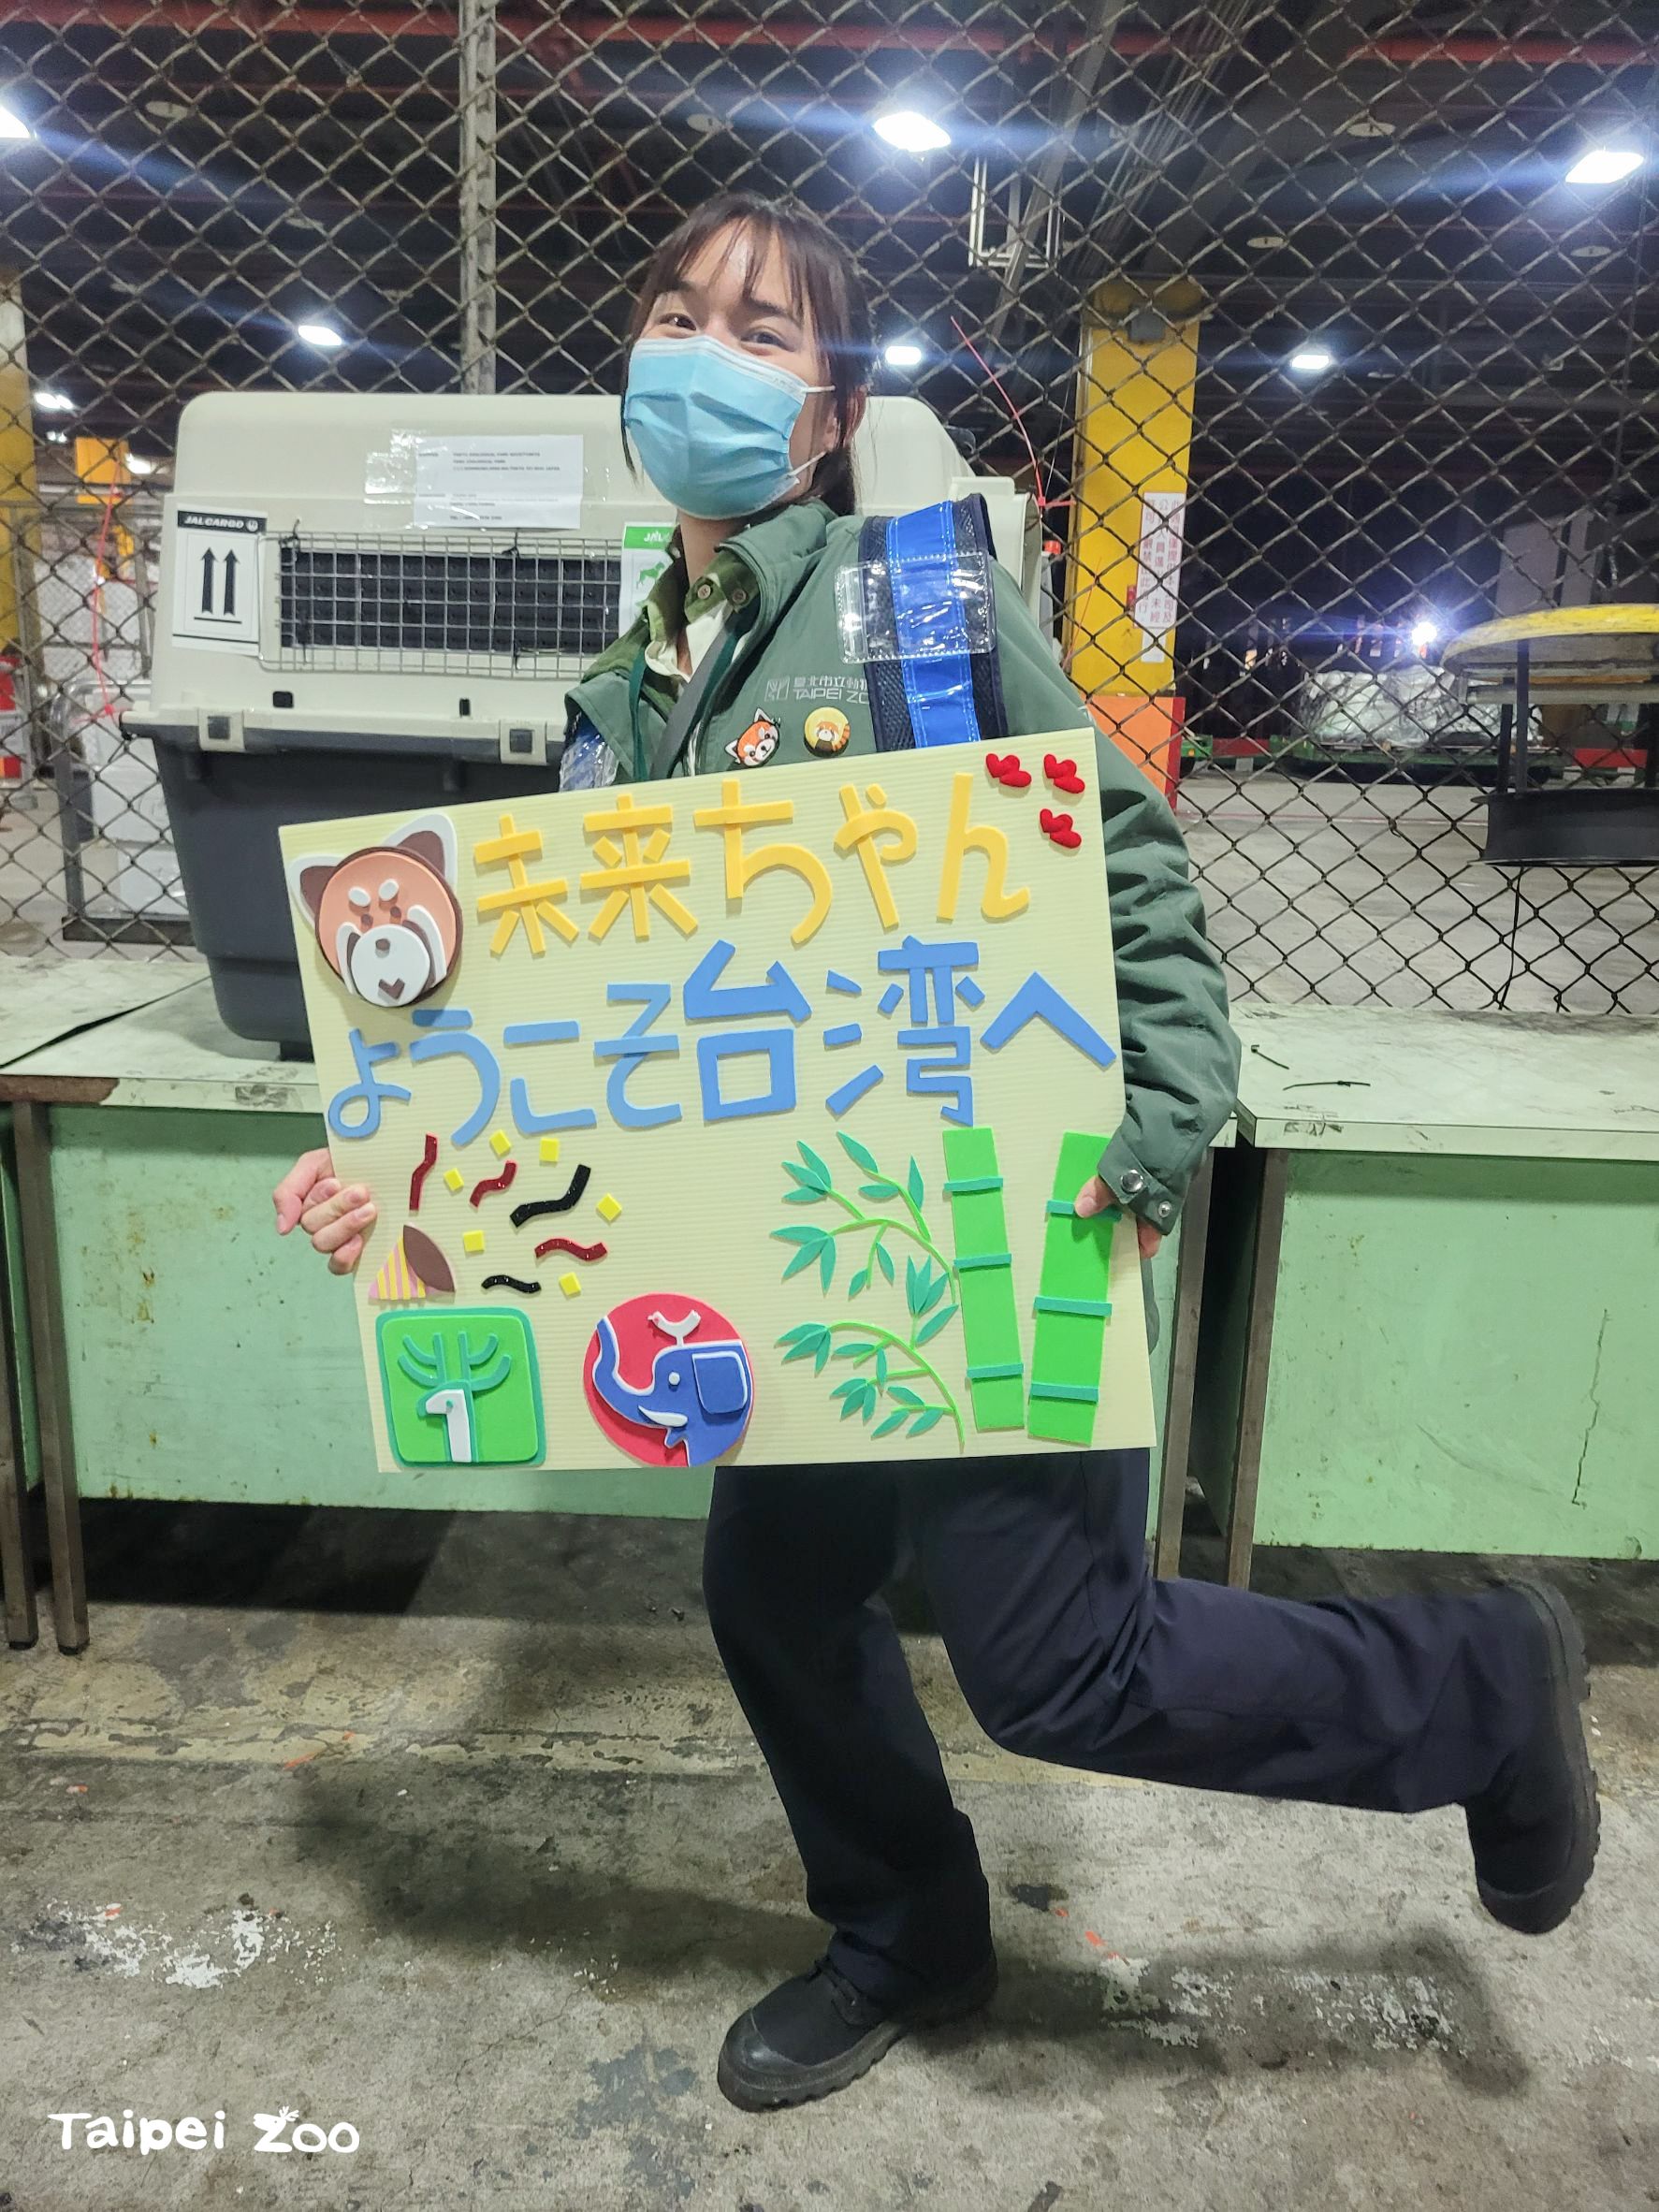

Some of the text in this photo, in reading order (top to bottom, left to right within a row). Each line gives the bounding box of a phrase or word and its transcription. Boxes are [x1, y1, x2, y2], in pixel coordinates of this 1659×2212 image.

[185, 517, 244, 529] JAL CARGO
[793, 687, 843, 701] TAIPEI
[473, 773, 1030, 955] 未来ちゃん
[327, 935, 1117, 1146] ようこそ台湾へ
